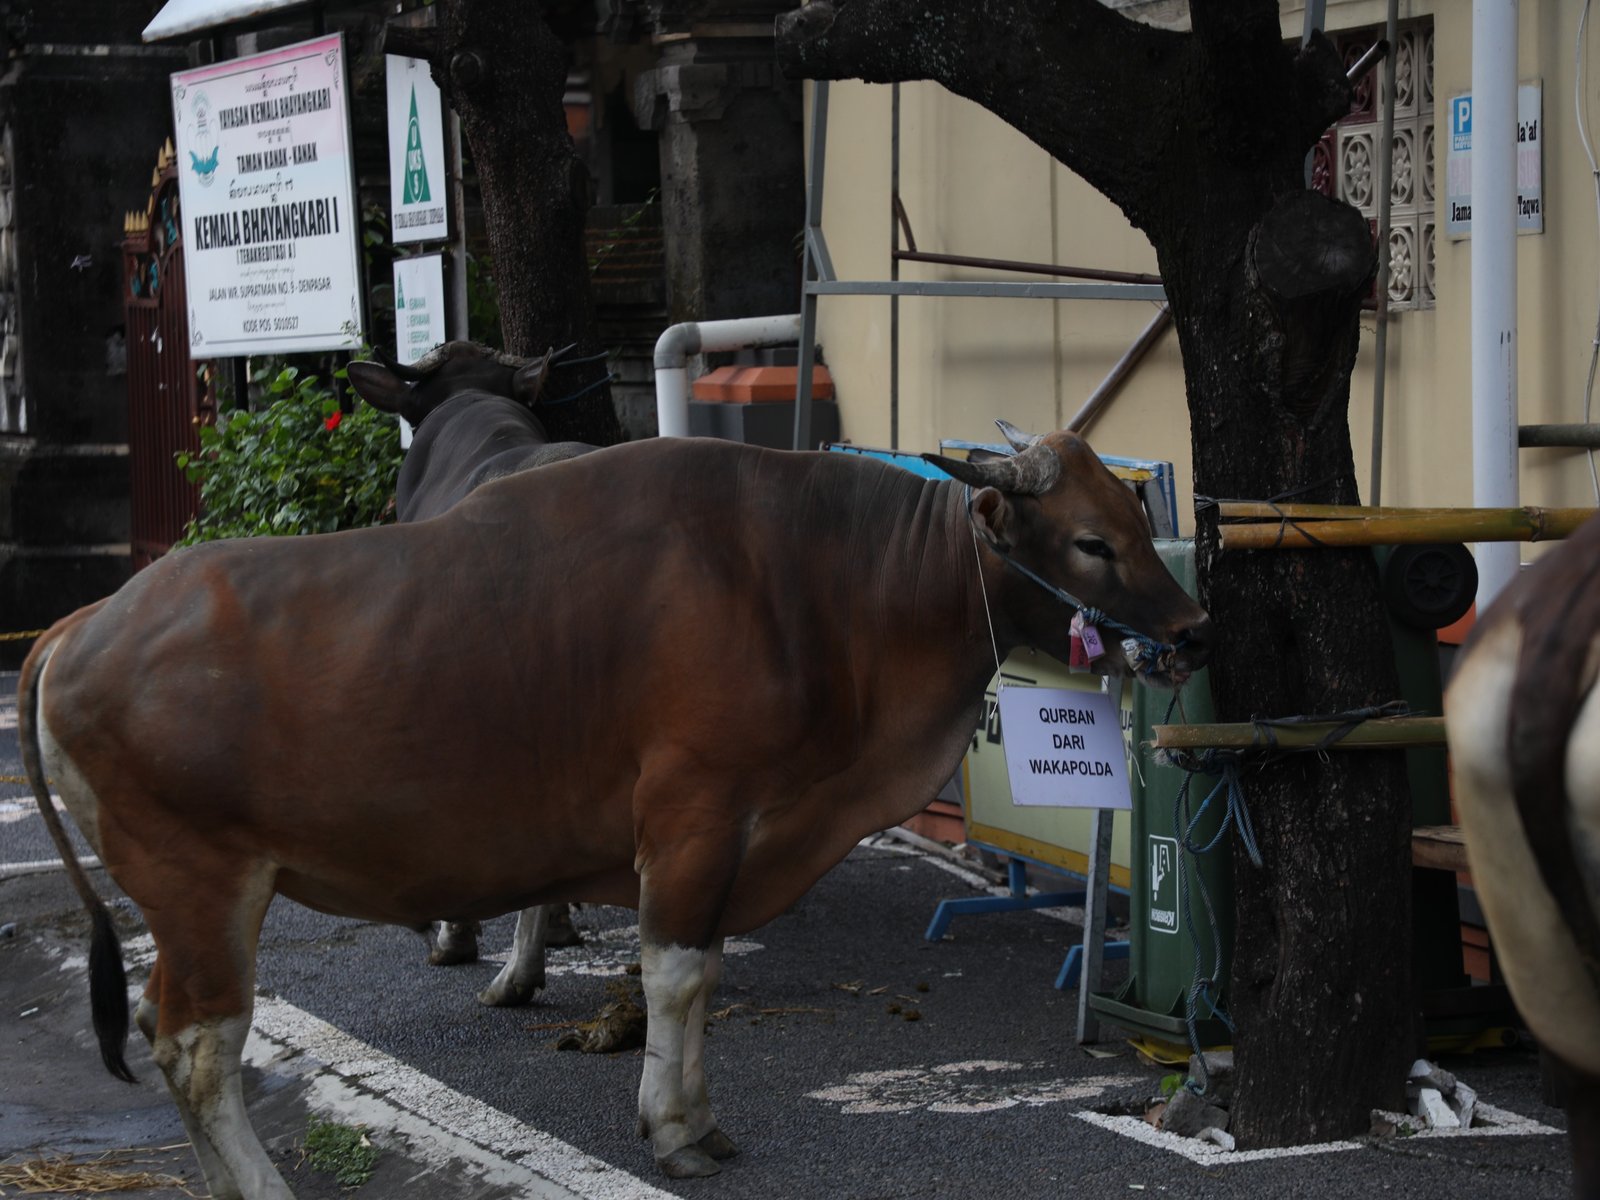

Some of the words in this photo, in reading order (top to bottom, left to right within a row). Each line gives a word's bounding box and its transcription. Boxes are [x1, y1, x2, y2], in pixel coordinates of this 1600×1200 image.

[219, 104, 249, 130] YAYASAN
[251, 99, 278, 124] KEMALA
[279, 87, 331, 119] BHAYANGKARI
[1458, 101, 1470, 132] P
[237, 151, 262, 174] TAMAN
[264, 148, 288, 171] KANAK
[292, 142, 318, 166] KANAK
[195, 210, 241, 251] KEMALA
[242, 197, 330, 245] BHAYANGKARI
[209, 287, 227, 301] JALAN
[240, 282, 278, 299] SUPRATMAN
[299, 276, 331, 294] DENPASAR
[1039, 707, 1095, 725] QURBAN
[1053, 734, 1085, 750] DARI
[1029, 759, 1114, 777] WAKAPOLDA
